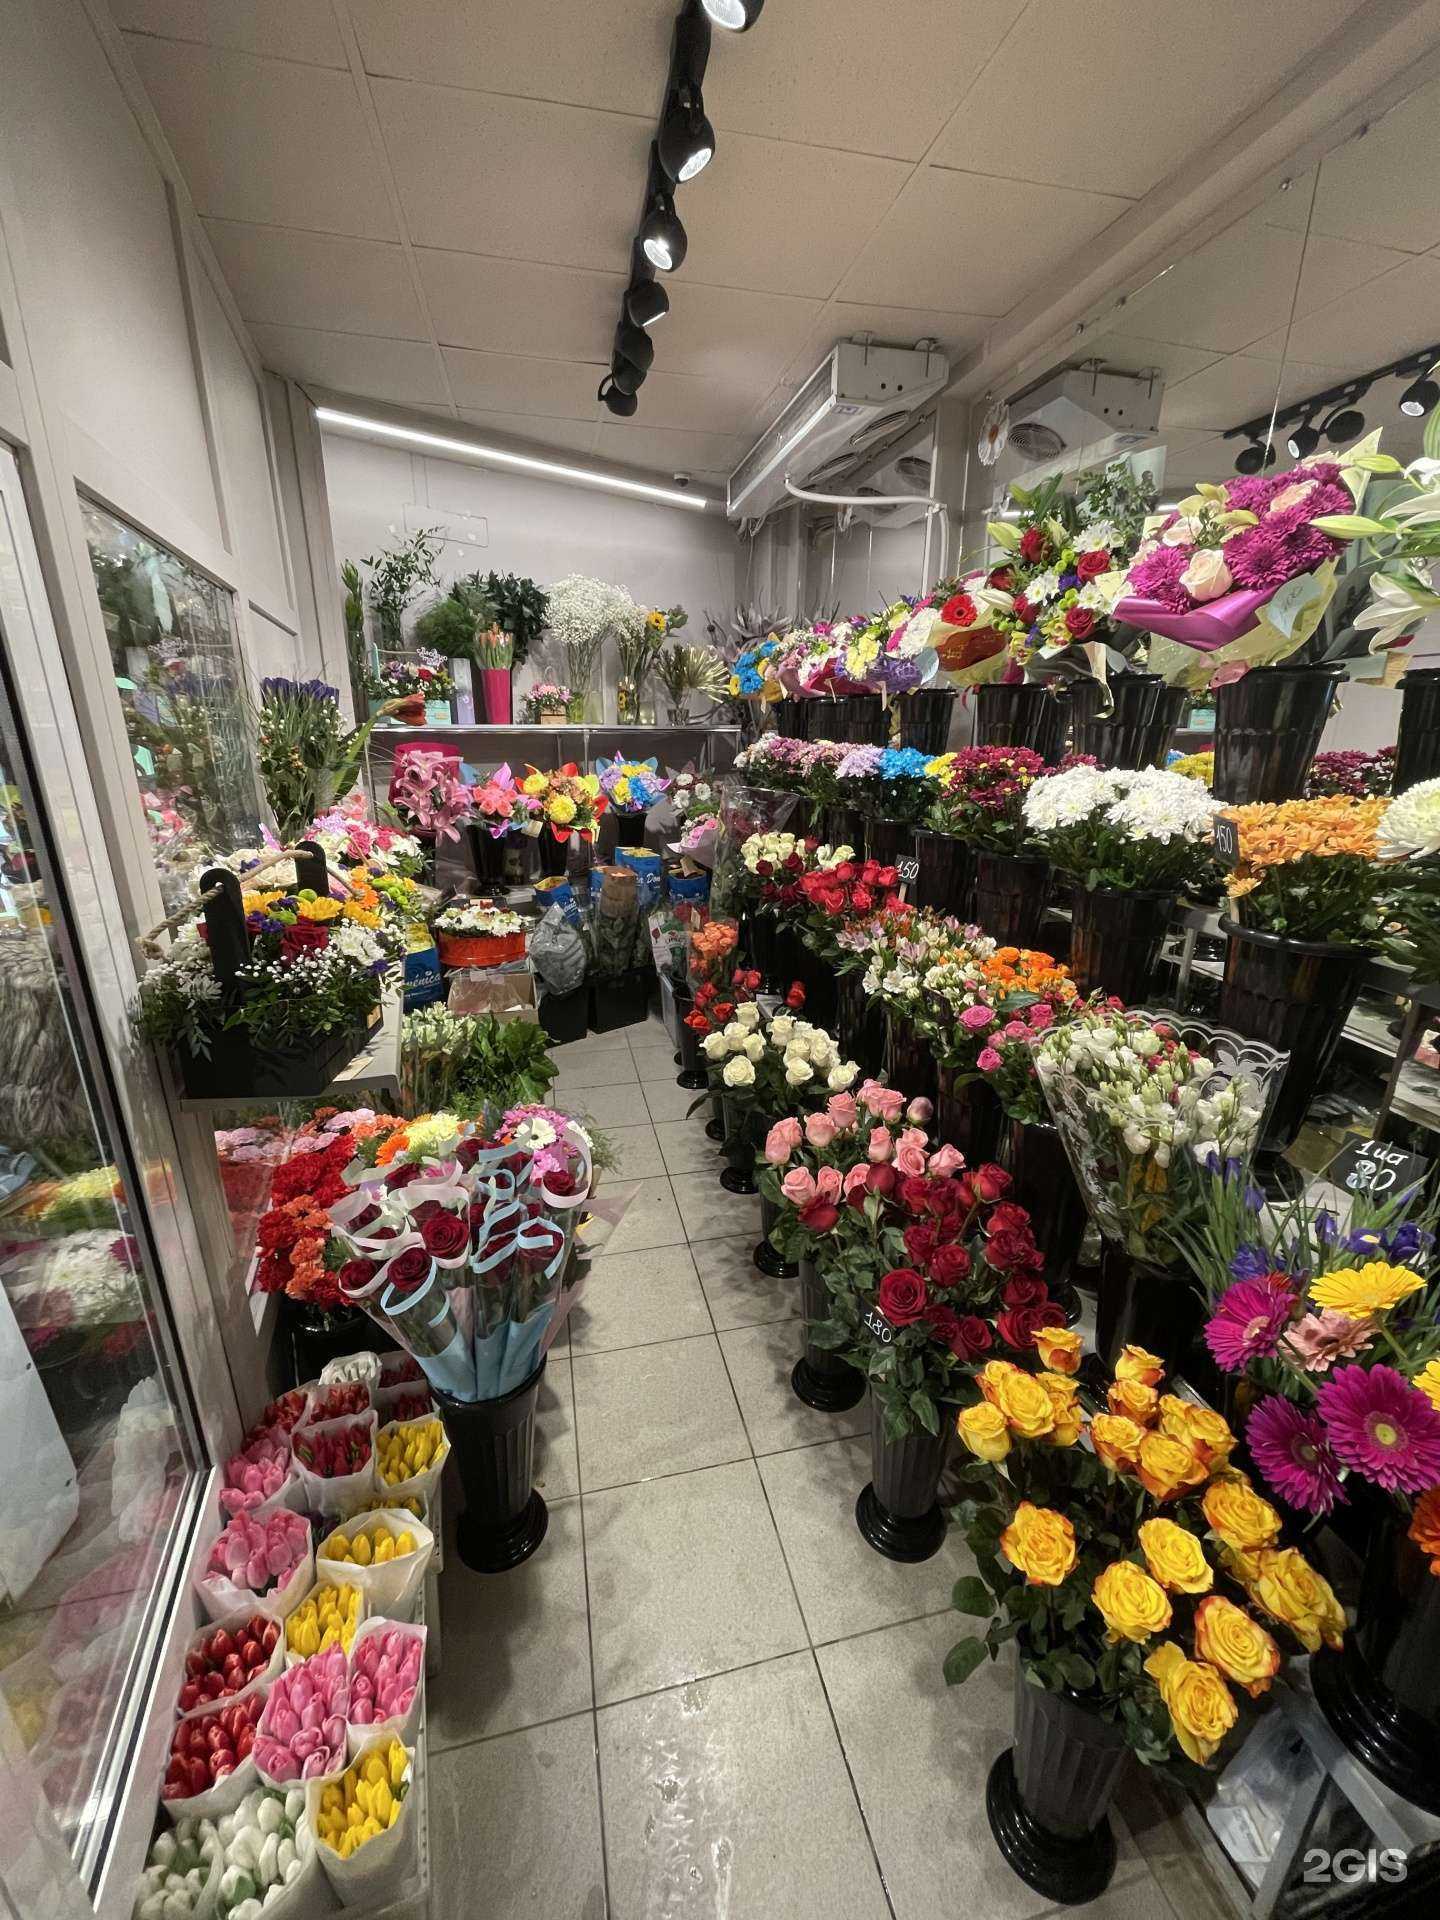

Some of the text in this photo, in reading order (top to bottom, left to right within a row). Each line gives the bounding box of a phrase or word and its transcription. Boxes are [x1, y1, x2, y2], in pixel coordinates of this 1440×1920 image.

[1216, 825, 1233, 854] 150
[896, 860, 920, 879] 150
[864, 1312, 892, 1343] 180
